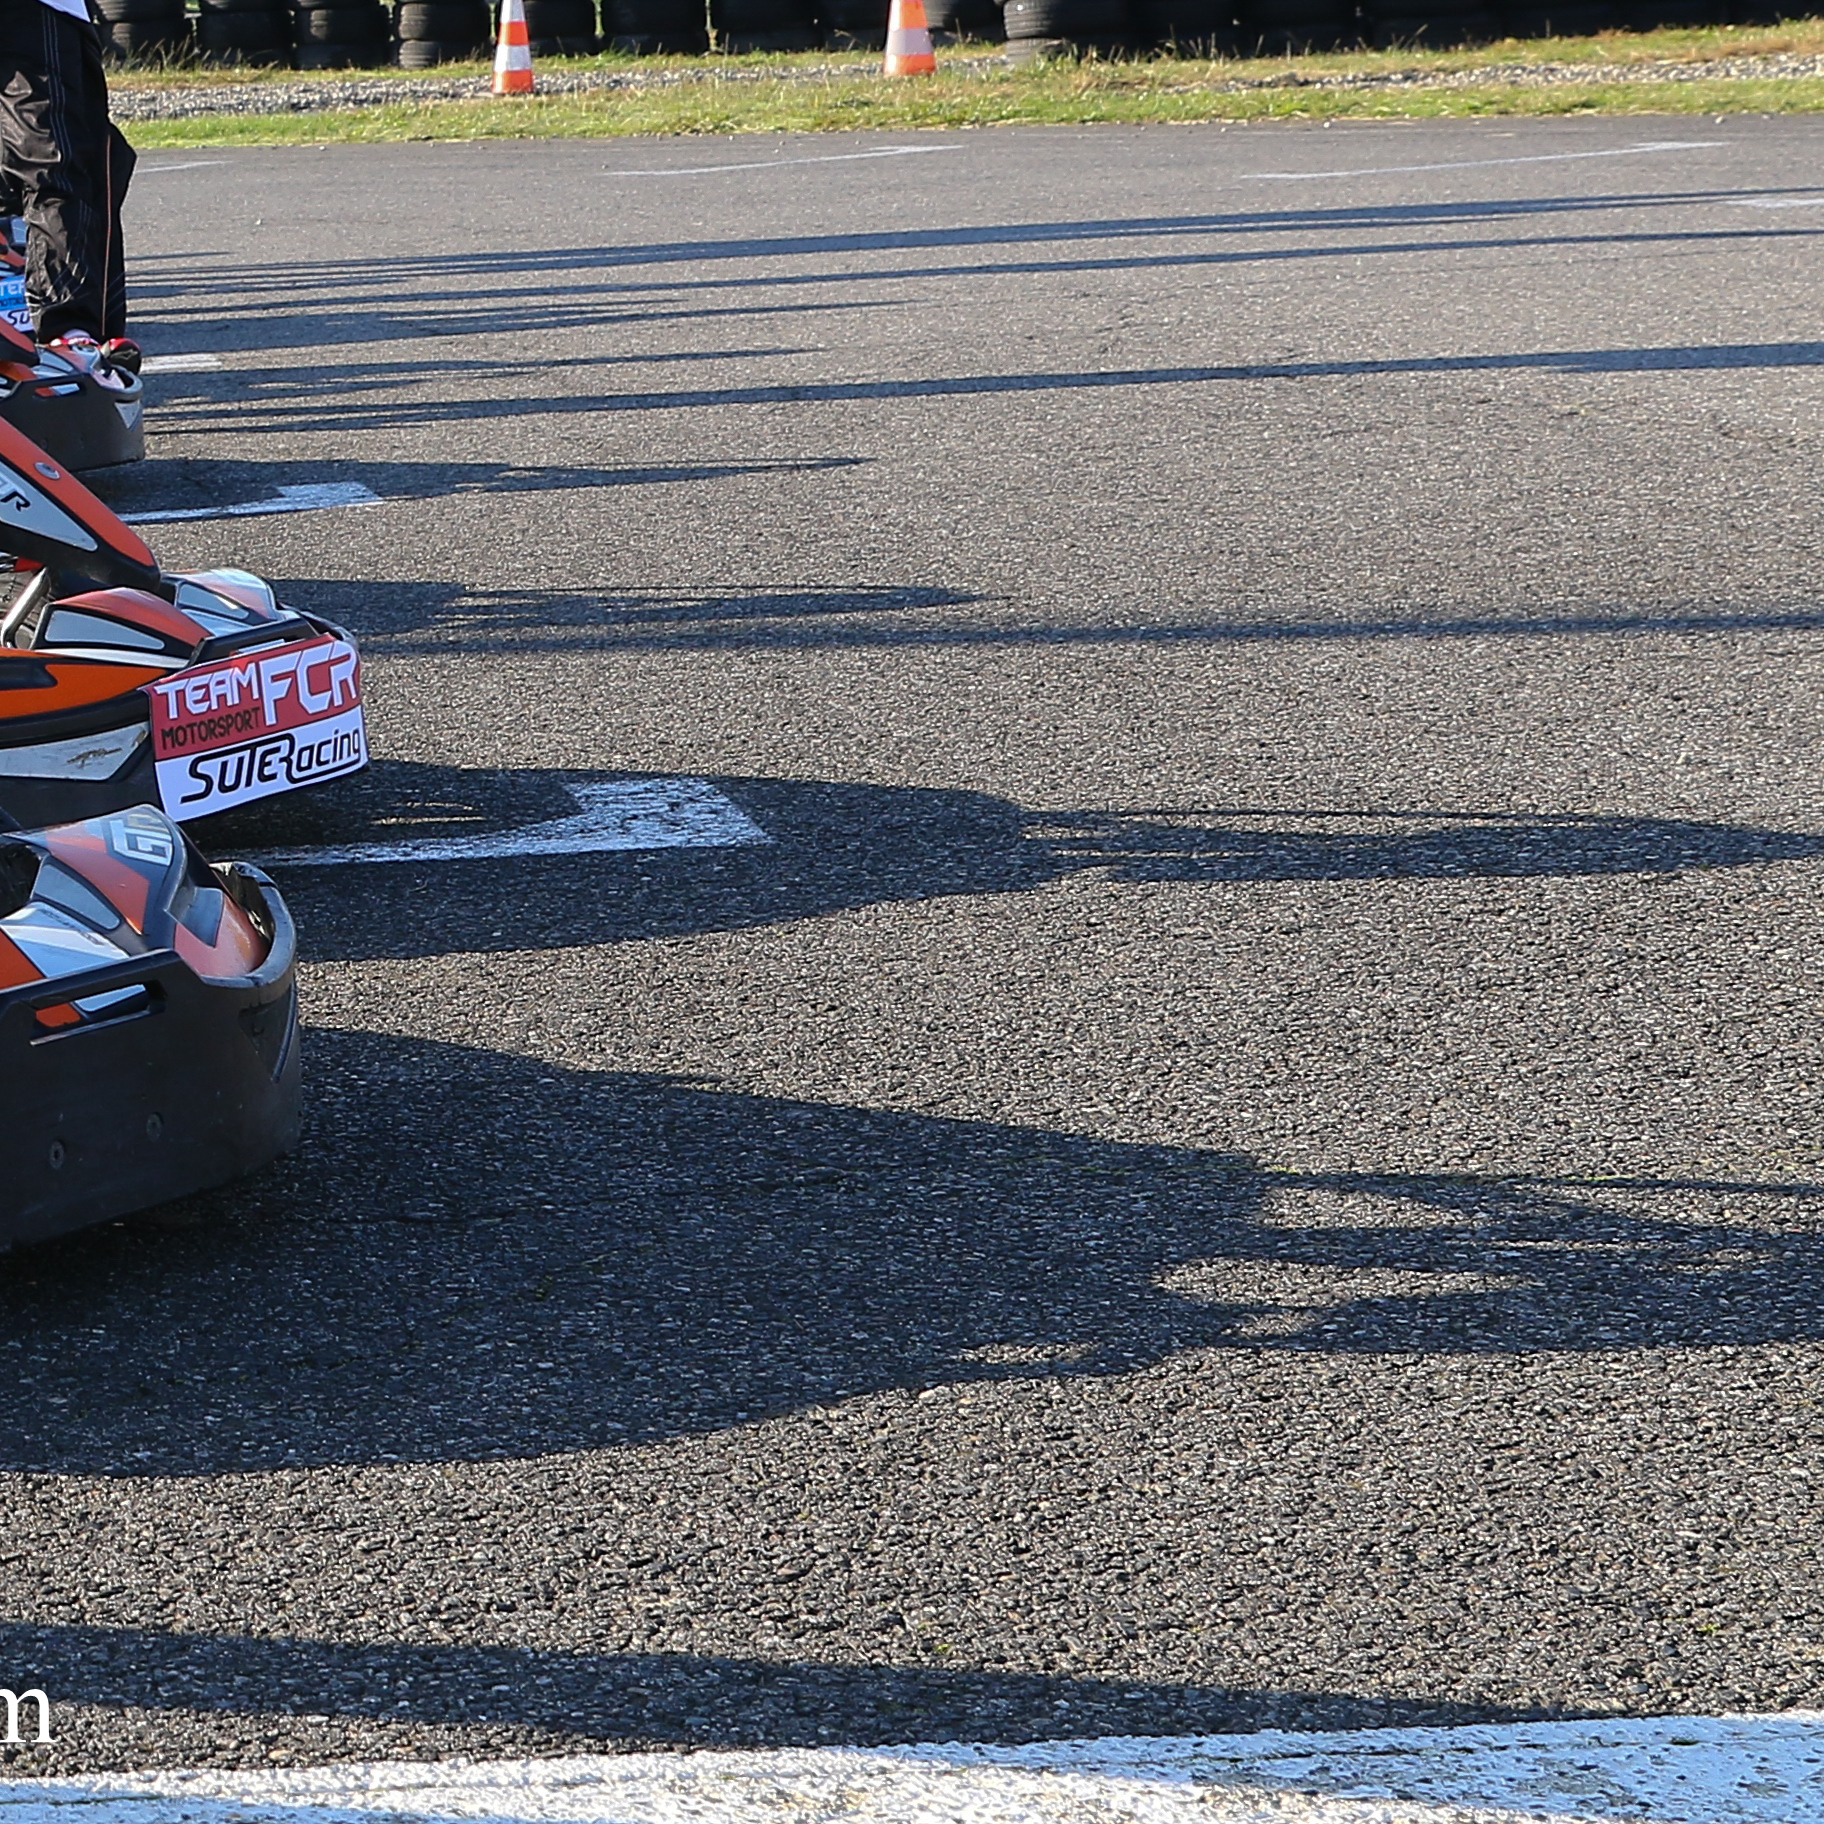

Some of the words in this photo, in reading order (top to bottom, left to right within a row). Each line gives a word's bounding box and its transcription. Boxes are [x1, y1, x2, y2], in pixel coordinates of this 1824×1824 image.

[154, 663, 260, 720] TEAM
[259, 640, 358, 726] FCR
[161, 707, 261, 751] MOTORSPORT
